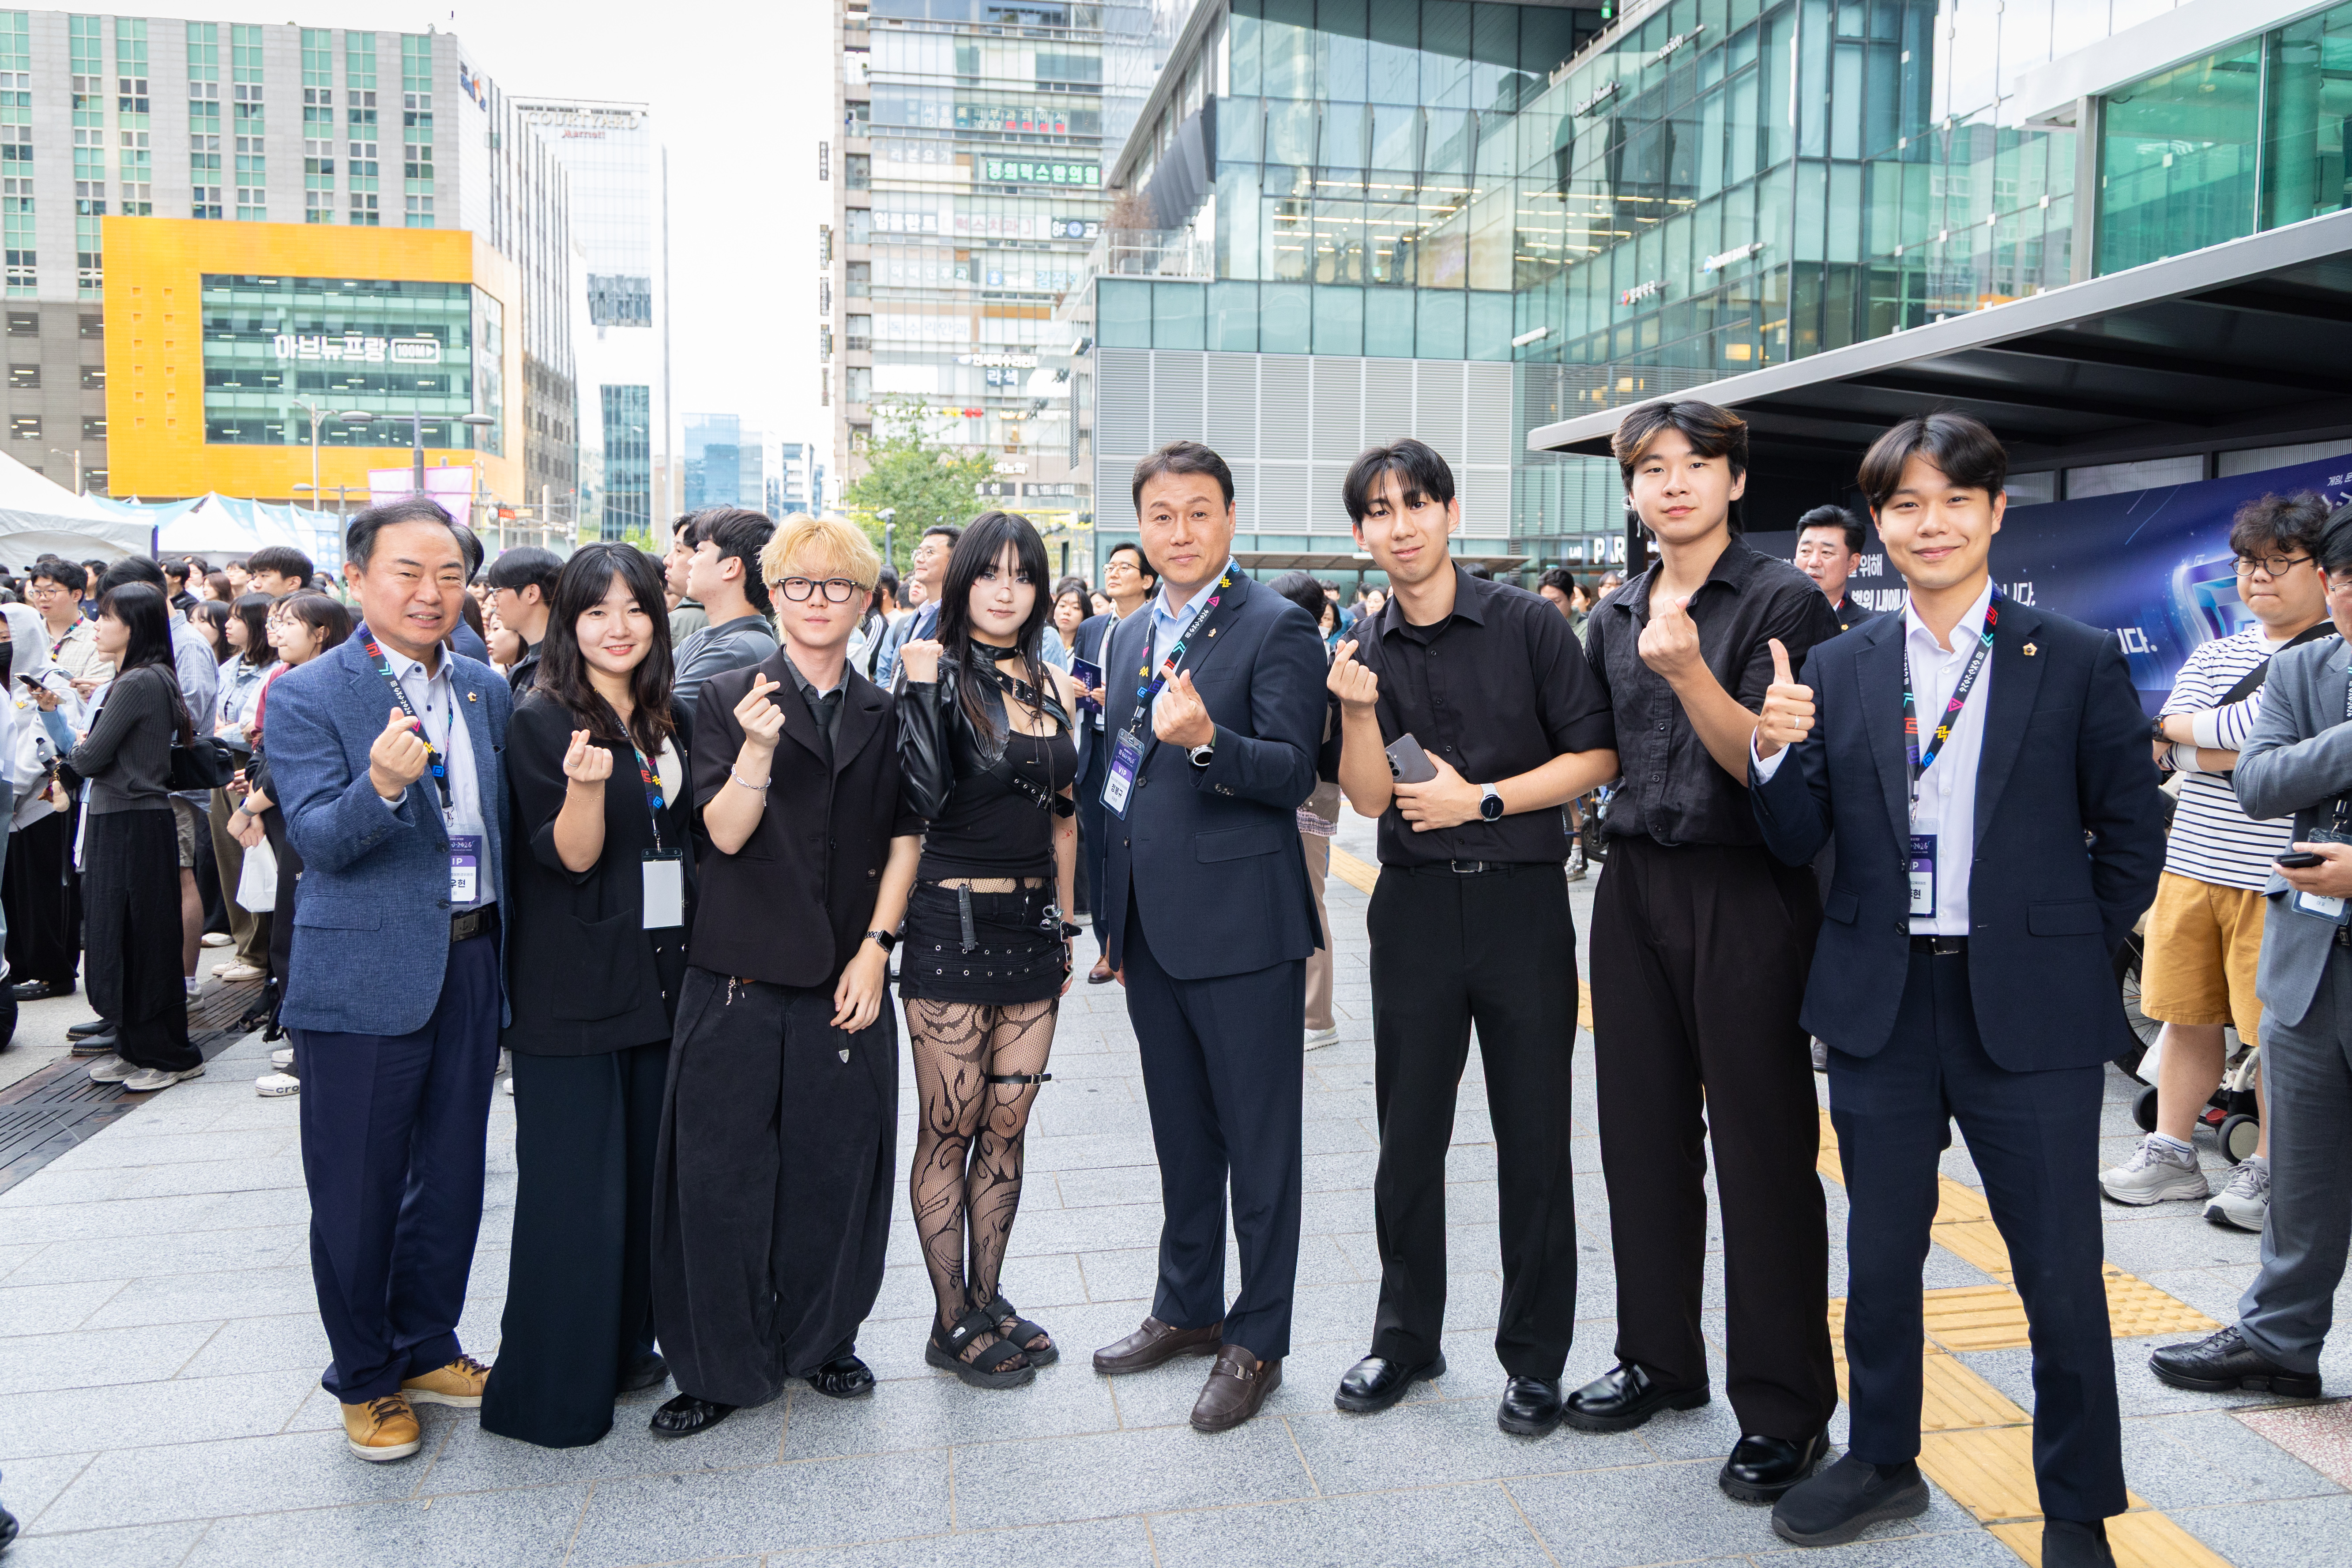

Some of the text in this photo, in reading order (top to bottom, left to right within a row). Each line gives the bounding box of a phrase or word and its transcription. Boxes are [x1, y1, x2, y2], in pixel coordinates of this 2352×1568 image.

[527, 112, 638, 129] COURTYARD
[562, 129, 605, 139] Marriott
[988, 162, 1099, 184] 경희럭스한의원
[874, 212, 937, 232] 임플란트
[274, 334, 426, 363] 아브뉴프랑 100M
[987, 369, 1019, 385] 라섹
[993, 462, 1028, 474] 비뇨의
[1859, 553, 1883, 577] 위해
[1118, 766, 1127, 776] VIP
[1111, 783, 1123, 798] 정봉규
[451, 879, 466, 888] 우현
[276, 1085, 300, 1094] cro
